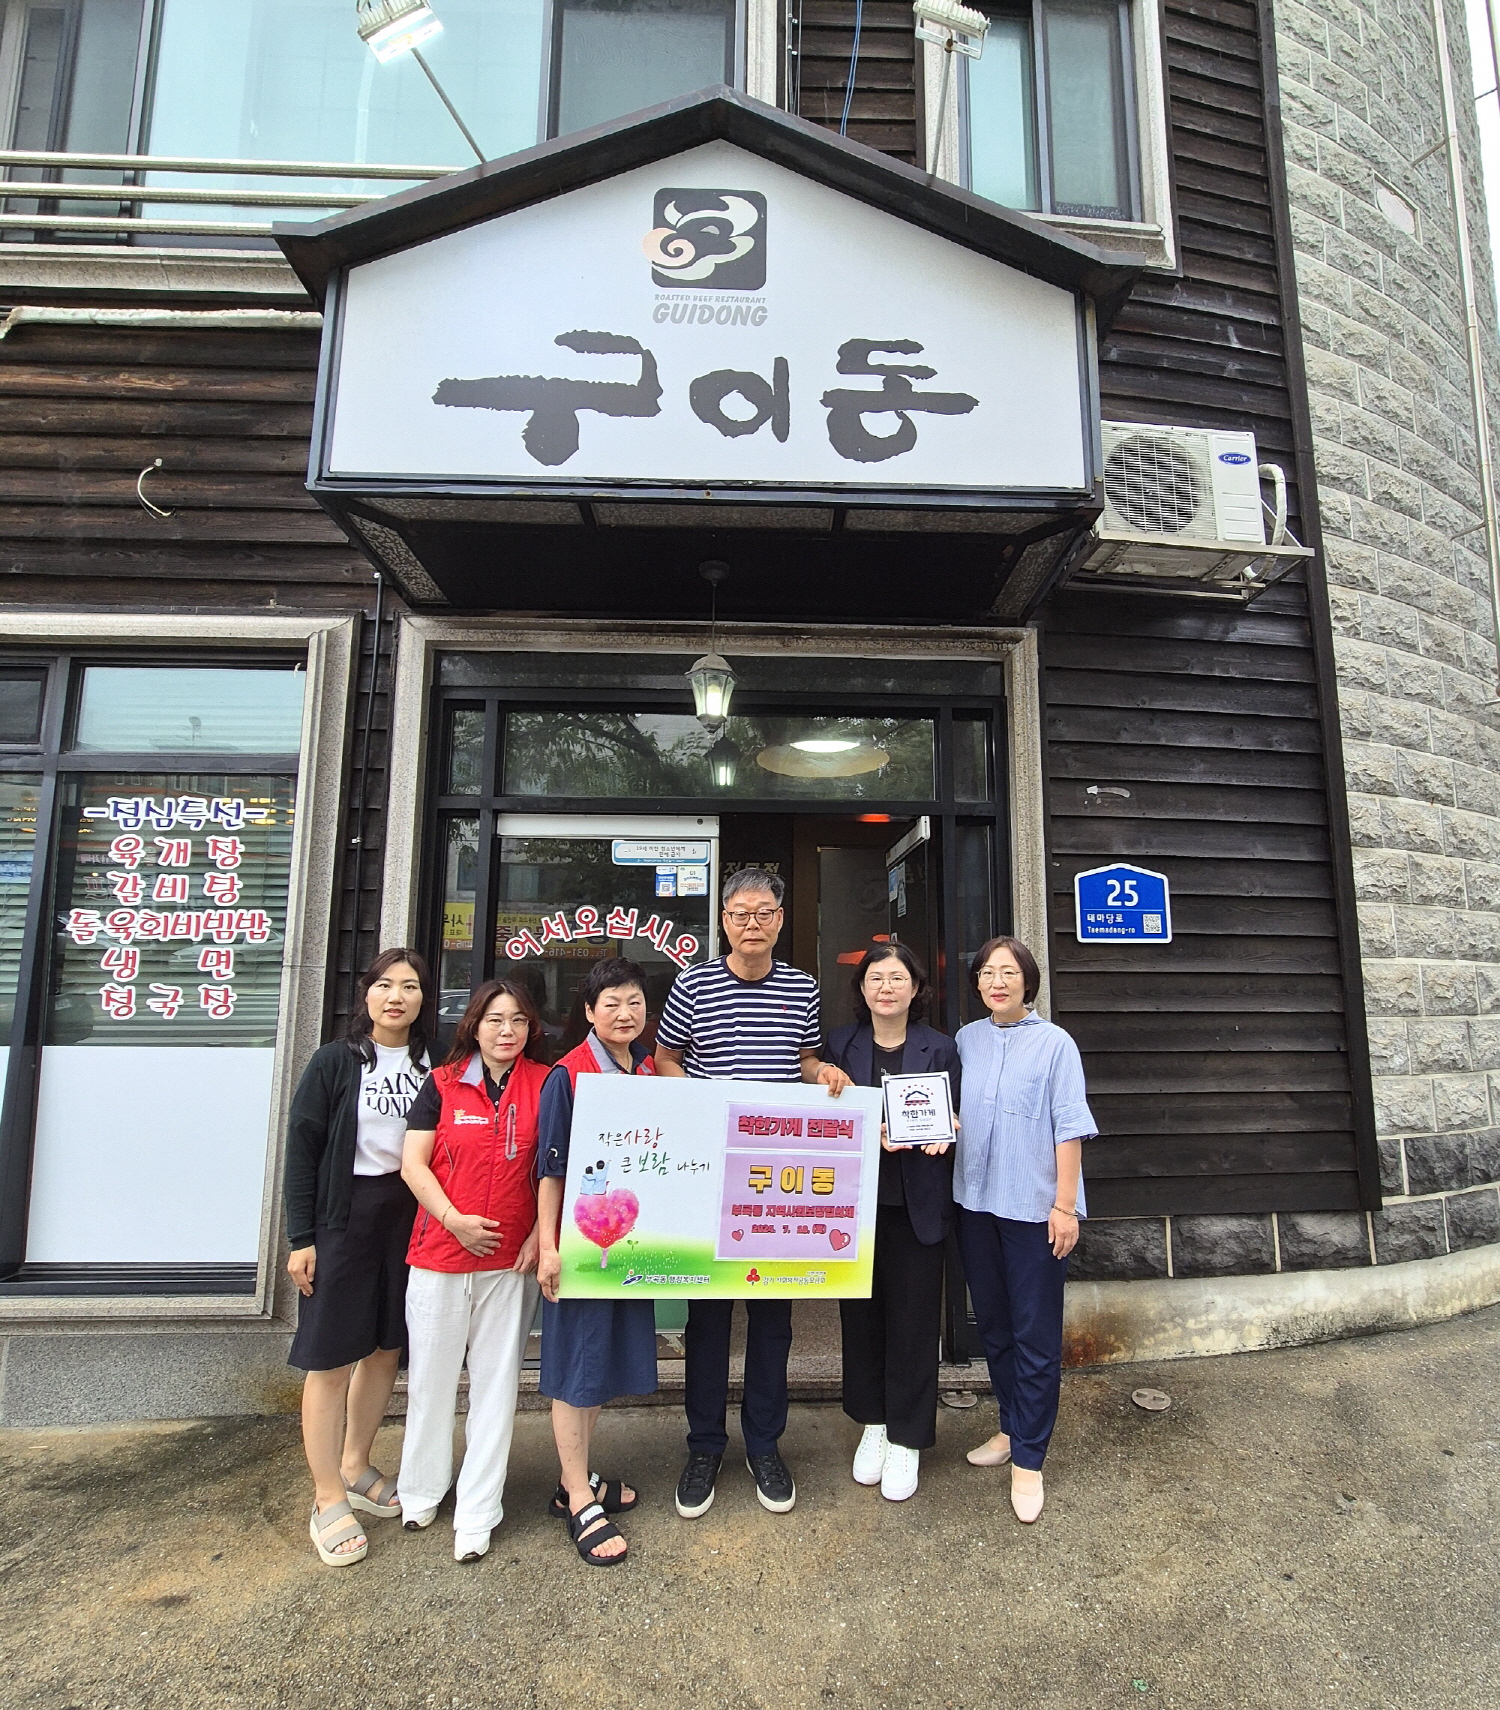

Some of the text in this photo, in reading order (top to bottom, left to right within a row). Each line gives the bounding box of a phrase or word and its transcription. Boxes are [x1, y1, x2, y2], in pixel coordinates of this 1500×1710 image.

[653, 303, 768, 326] GUIDONG
[432, 330, 980, 466] 구이동
[1222, 454, 1247, 462] Carrier
[1107, 880, 1139, 907] 25
[69, 910, 269, 941] 돌육회비빔밥
[506, 903, 699, 969] 어서오십시오
[1087, 926, 1136, 935] Taemadang-ro
[365, 1072, 425, 1096] SAIN
[902, 1109, 936, 1119] 착한가게
[738, 1115, 855, 1139] 착한가게 전달식
[620, 1151, 710, 1175] 큰 보람 나누기
[731, 1204, 855, 1218] 부곡동 지역사회보장협의체
[646, 1275, 710, 1284] 부곡동 행정복지센터
